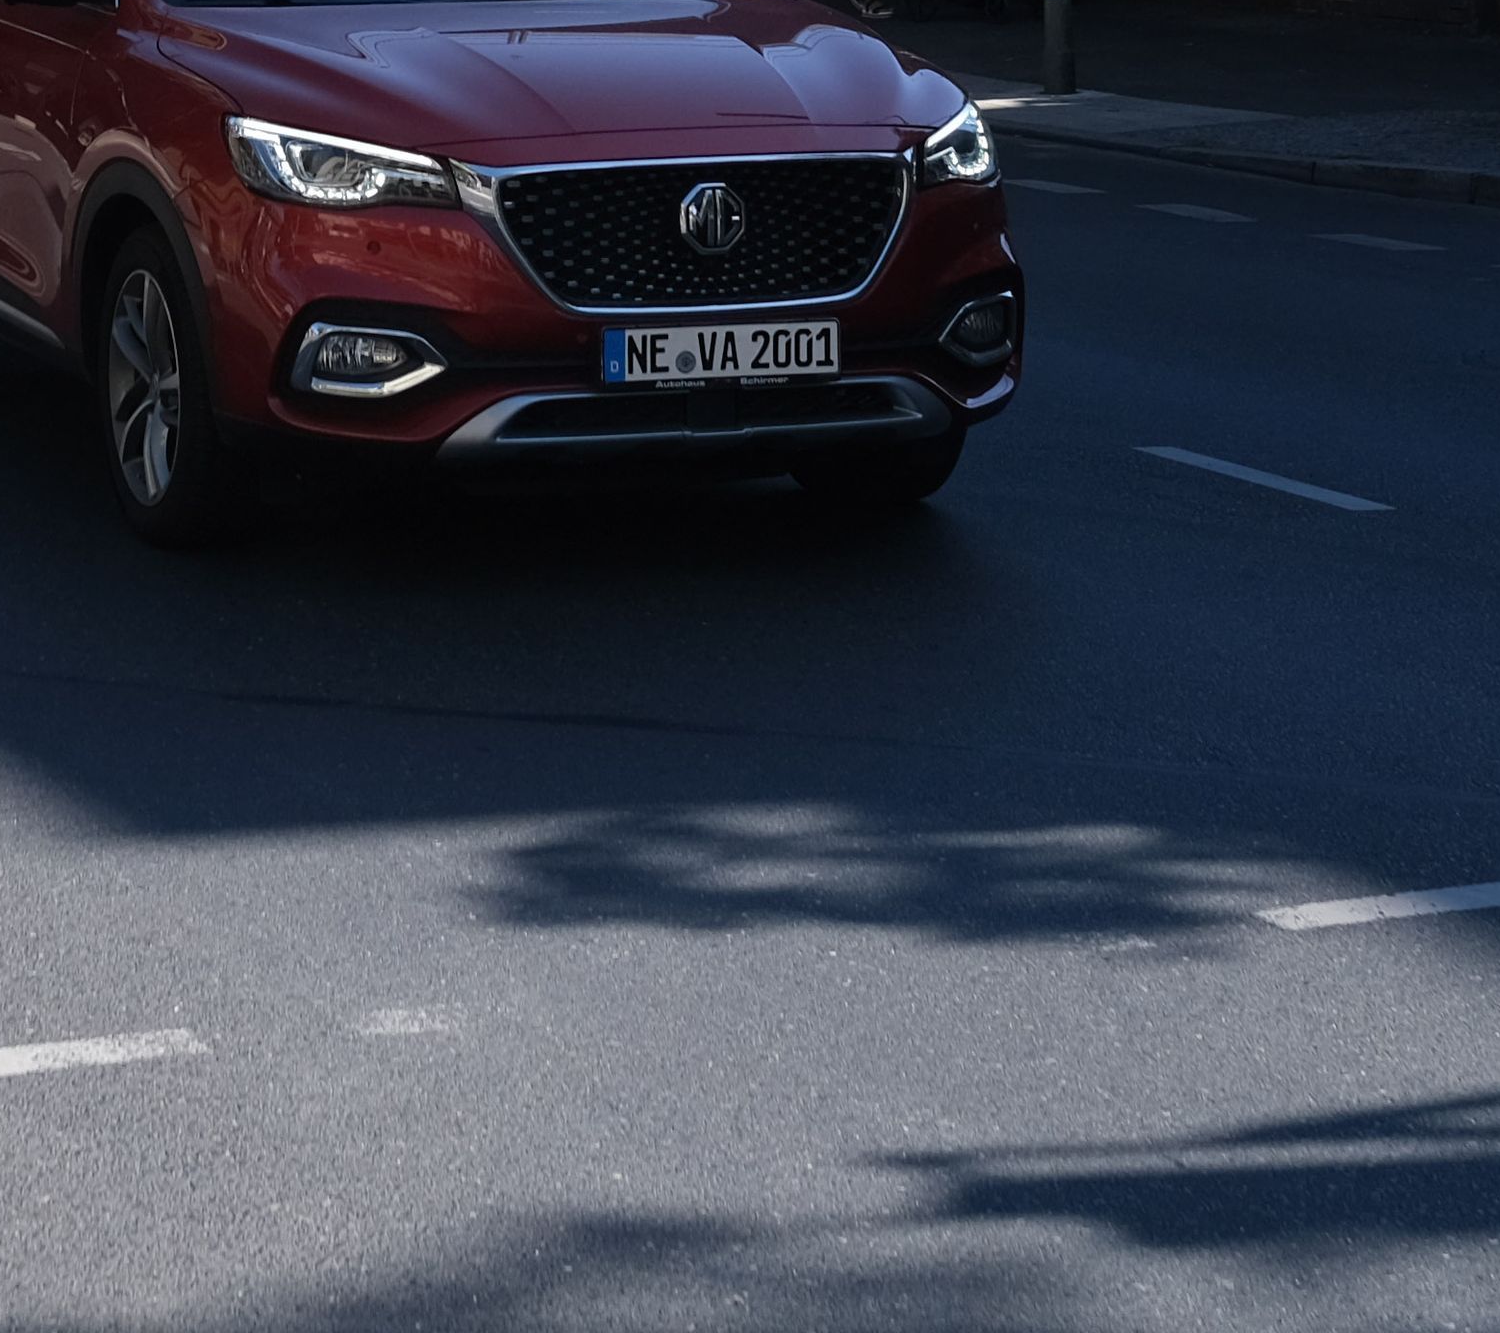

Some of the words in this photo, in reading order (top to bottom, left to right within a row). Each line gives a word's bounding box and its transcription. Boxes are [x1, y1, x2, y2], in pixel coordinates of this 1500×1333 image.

[688, 188, 740, 247] MG
[611, 360, 619, 373] D
[627, 333, 670, 374] NE
[697, 330, 740, 371] VA
[751, 327, 835, 369] 2001
[655, 379, 707, 389] Autohaus
